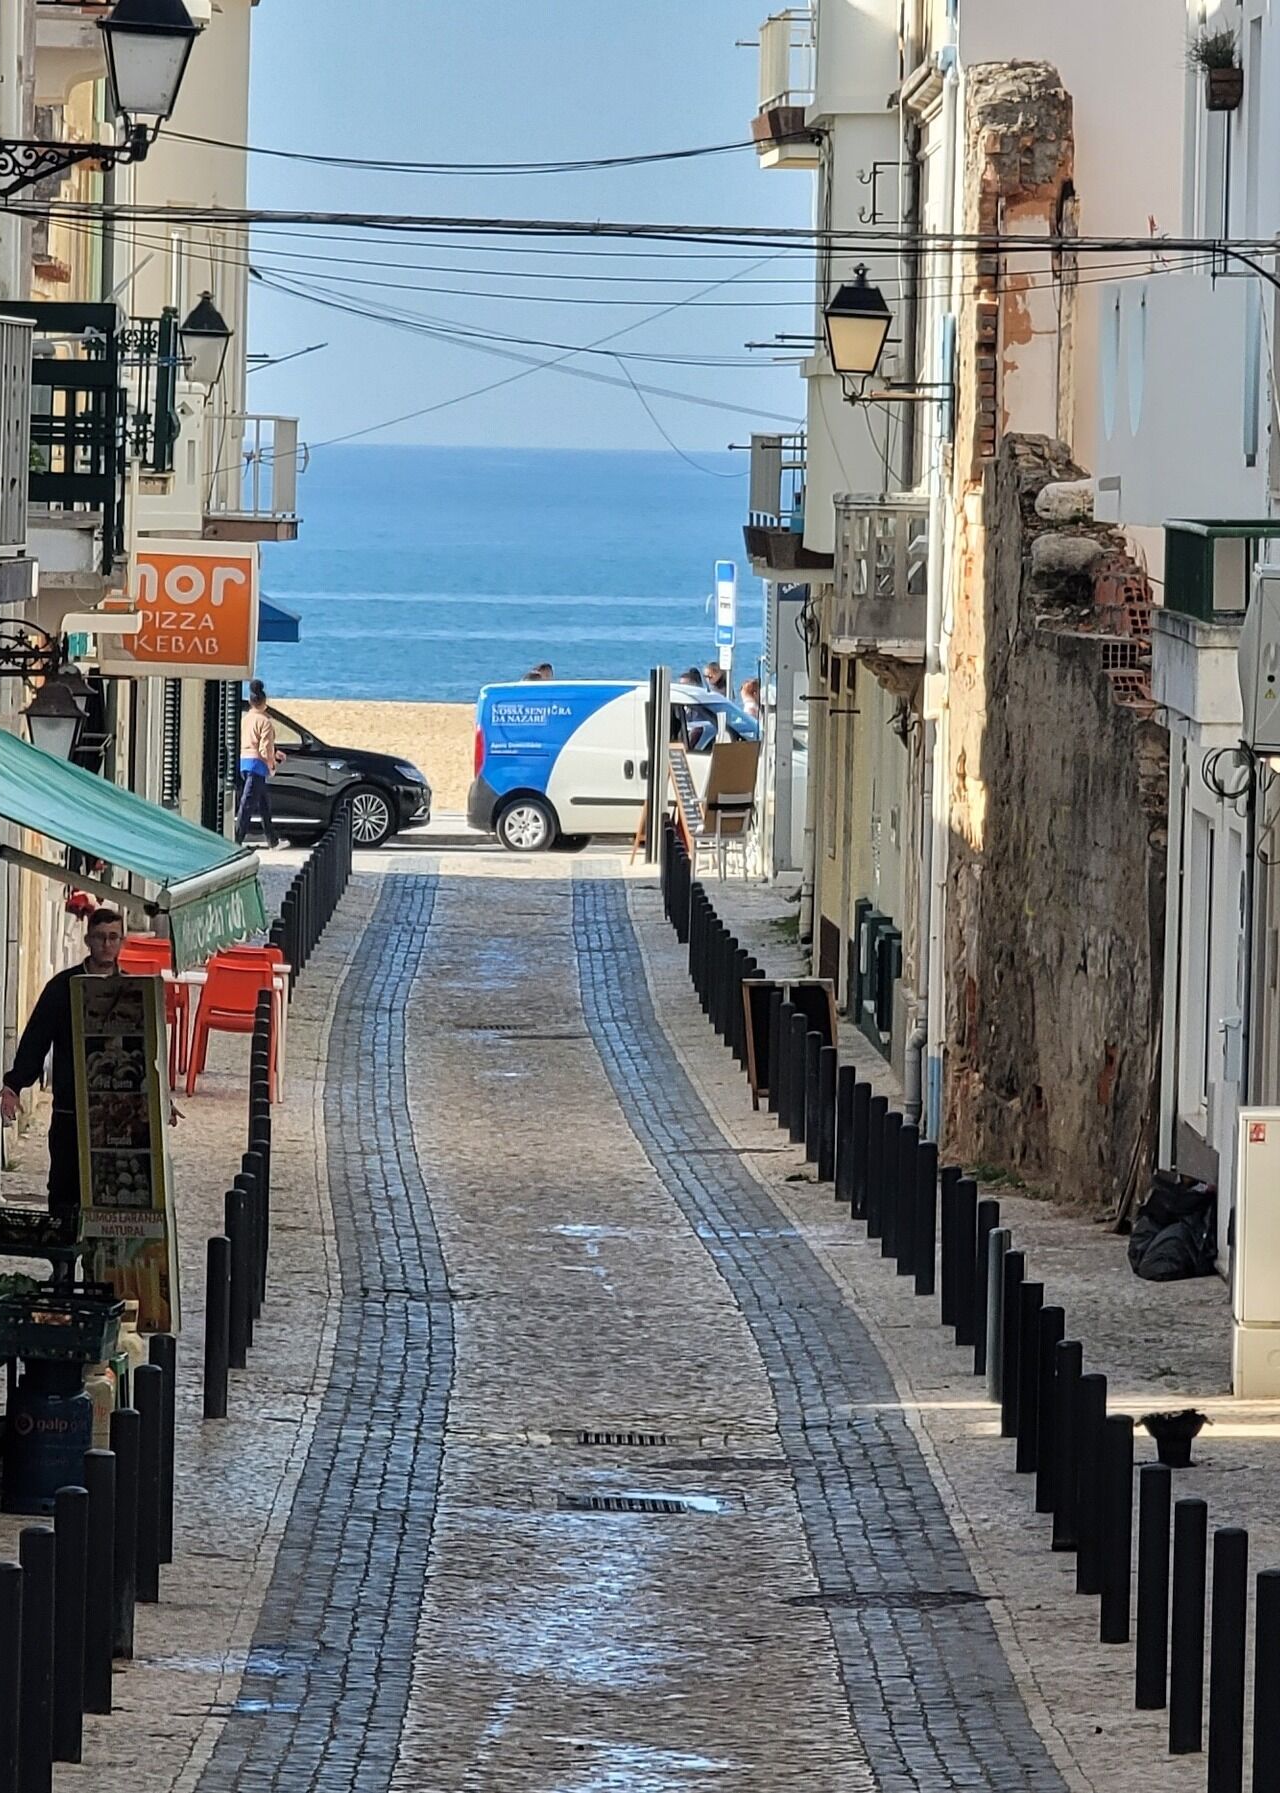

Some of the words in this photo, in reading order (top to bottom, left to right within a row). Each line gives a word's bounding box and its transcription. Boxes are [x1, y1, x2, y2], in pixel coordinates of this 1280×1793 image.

[140, 611, 215, 631] PIZZA
[133, 634, 219, 655] KEBAB
[101, 1224, 146, 1237] NATURAL
[36, 1417, 68, 1432] galp
